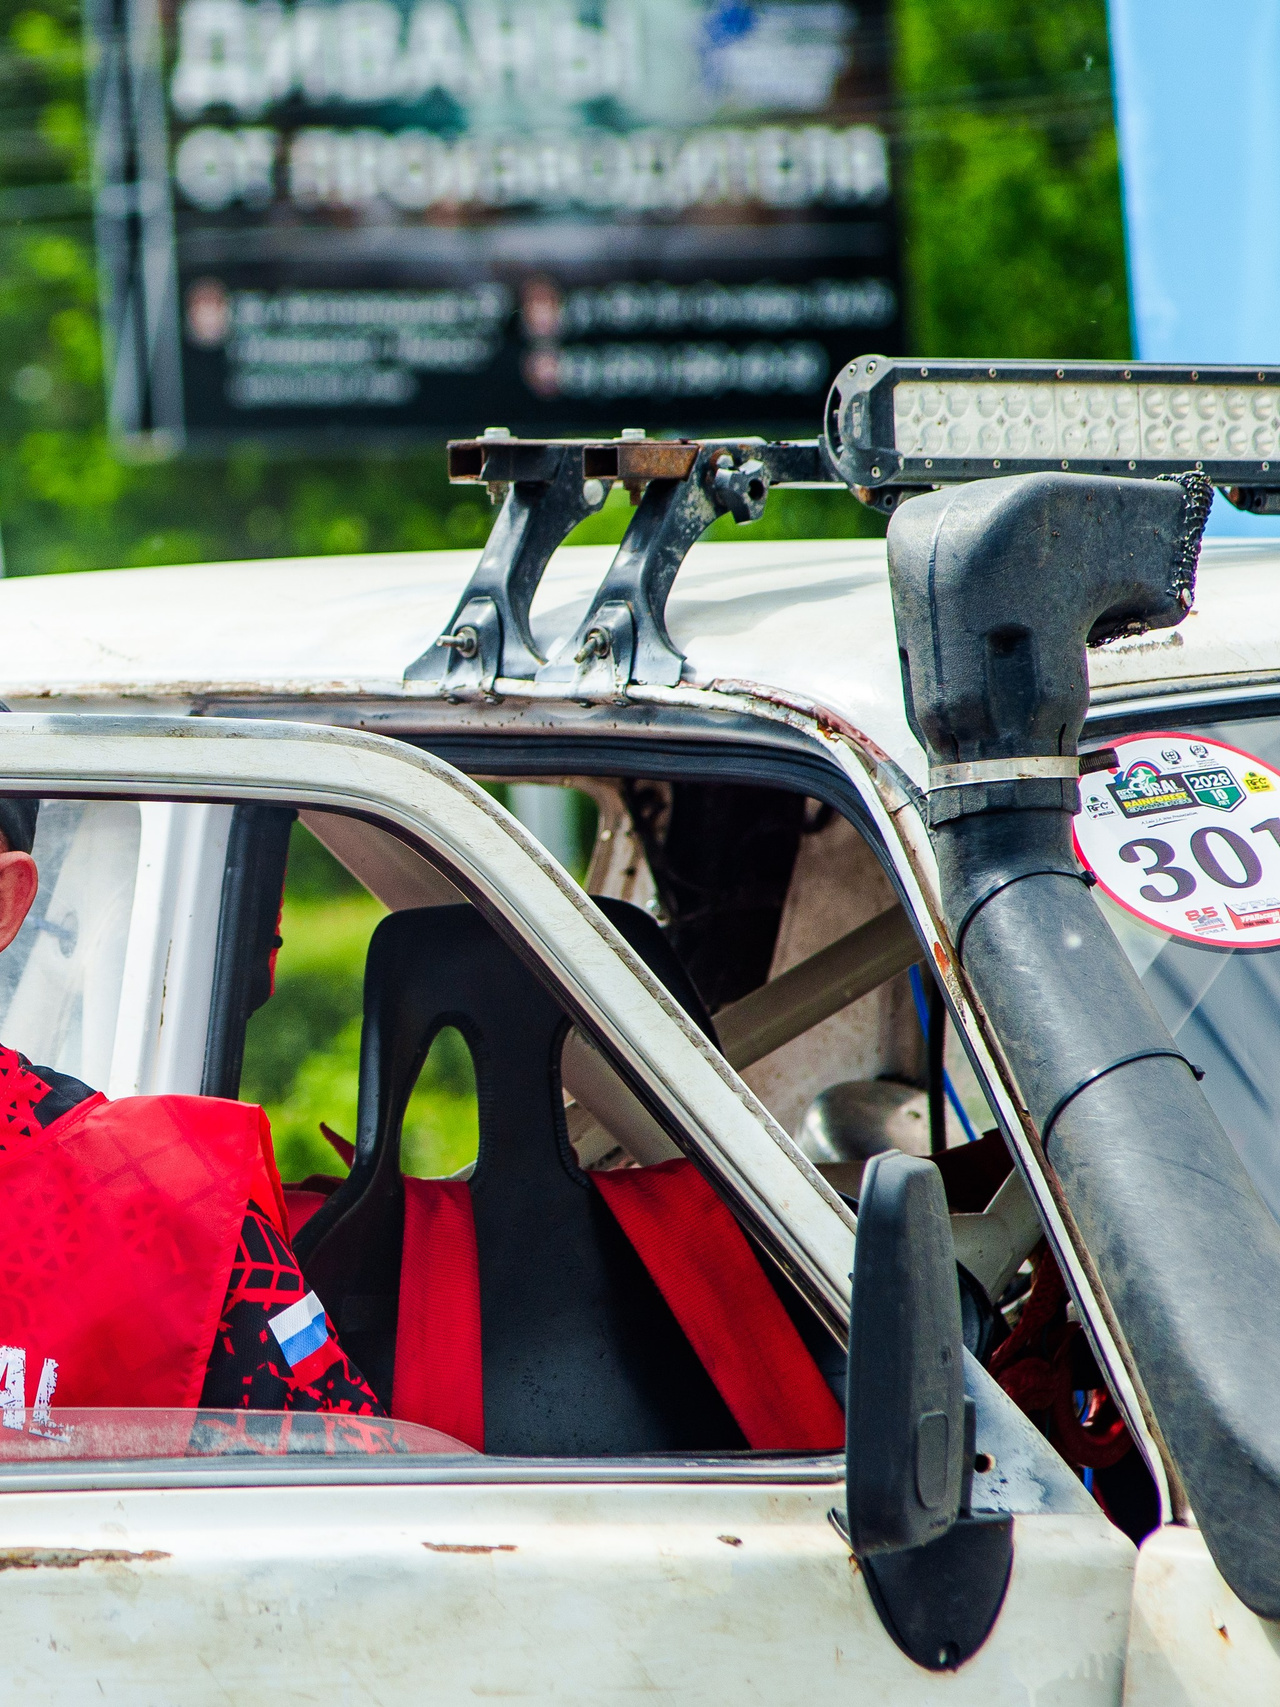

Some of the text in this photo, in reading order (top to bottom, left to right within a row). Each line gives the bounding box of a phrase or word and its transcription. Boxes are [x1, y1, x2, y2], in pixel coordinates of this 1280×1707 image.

[170, 0, 637, 118] ДИВАНЫ
[176, 125, 276, 211] ОТ
[1189, 773, 1232, 790] 2026
[1122, 791, 1189, 809] RAINFOREST
[1210, 789, 1229, 801] 10
[1185, 906, 1218, 921] 85
